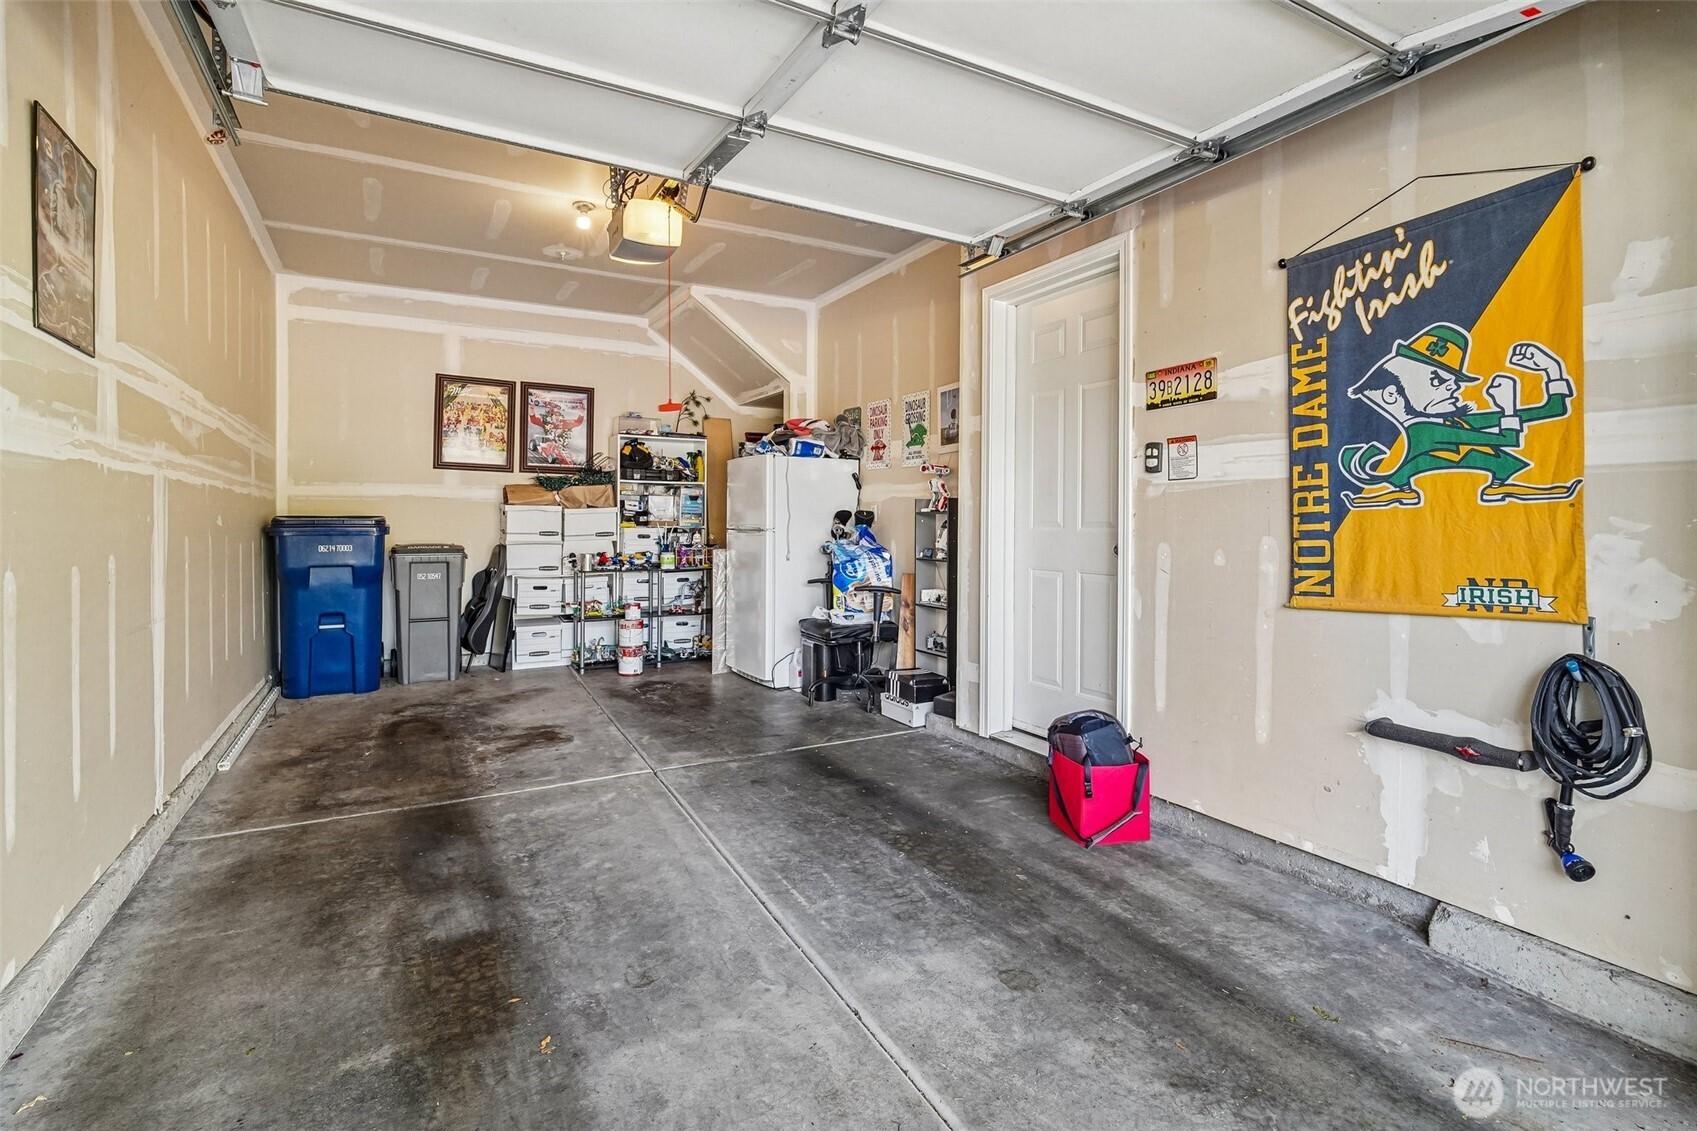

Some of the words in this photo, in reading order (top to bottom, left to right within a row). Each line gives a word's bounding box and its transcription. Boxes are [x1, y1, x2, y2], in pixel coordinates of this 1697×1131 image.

[1355, 239, 1448, 335] Irish
[1164, 364, 1196, 376] INDIANA
[869, 404, 888, 418] DINOSAUR
[905, 397, 926, 413] DINOSAUR
[869, 415, 888, 429] PARKING
[905, 410, 926, 425] CROSSING
[873, 428, 884, 440] ONLY
[1459, 587, 1534, 606] IRISH
